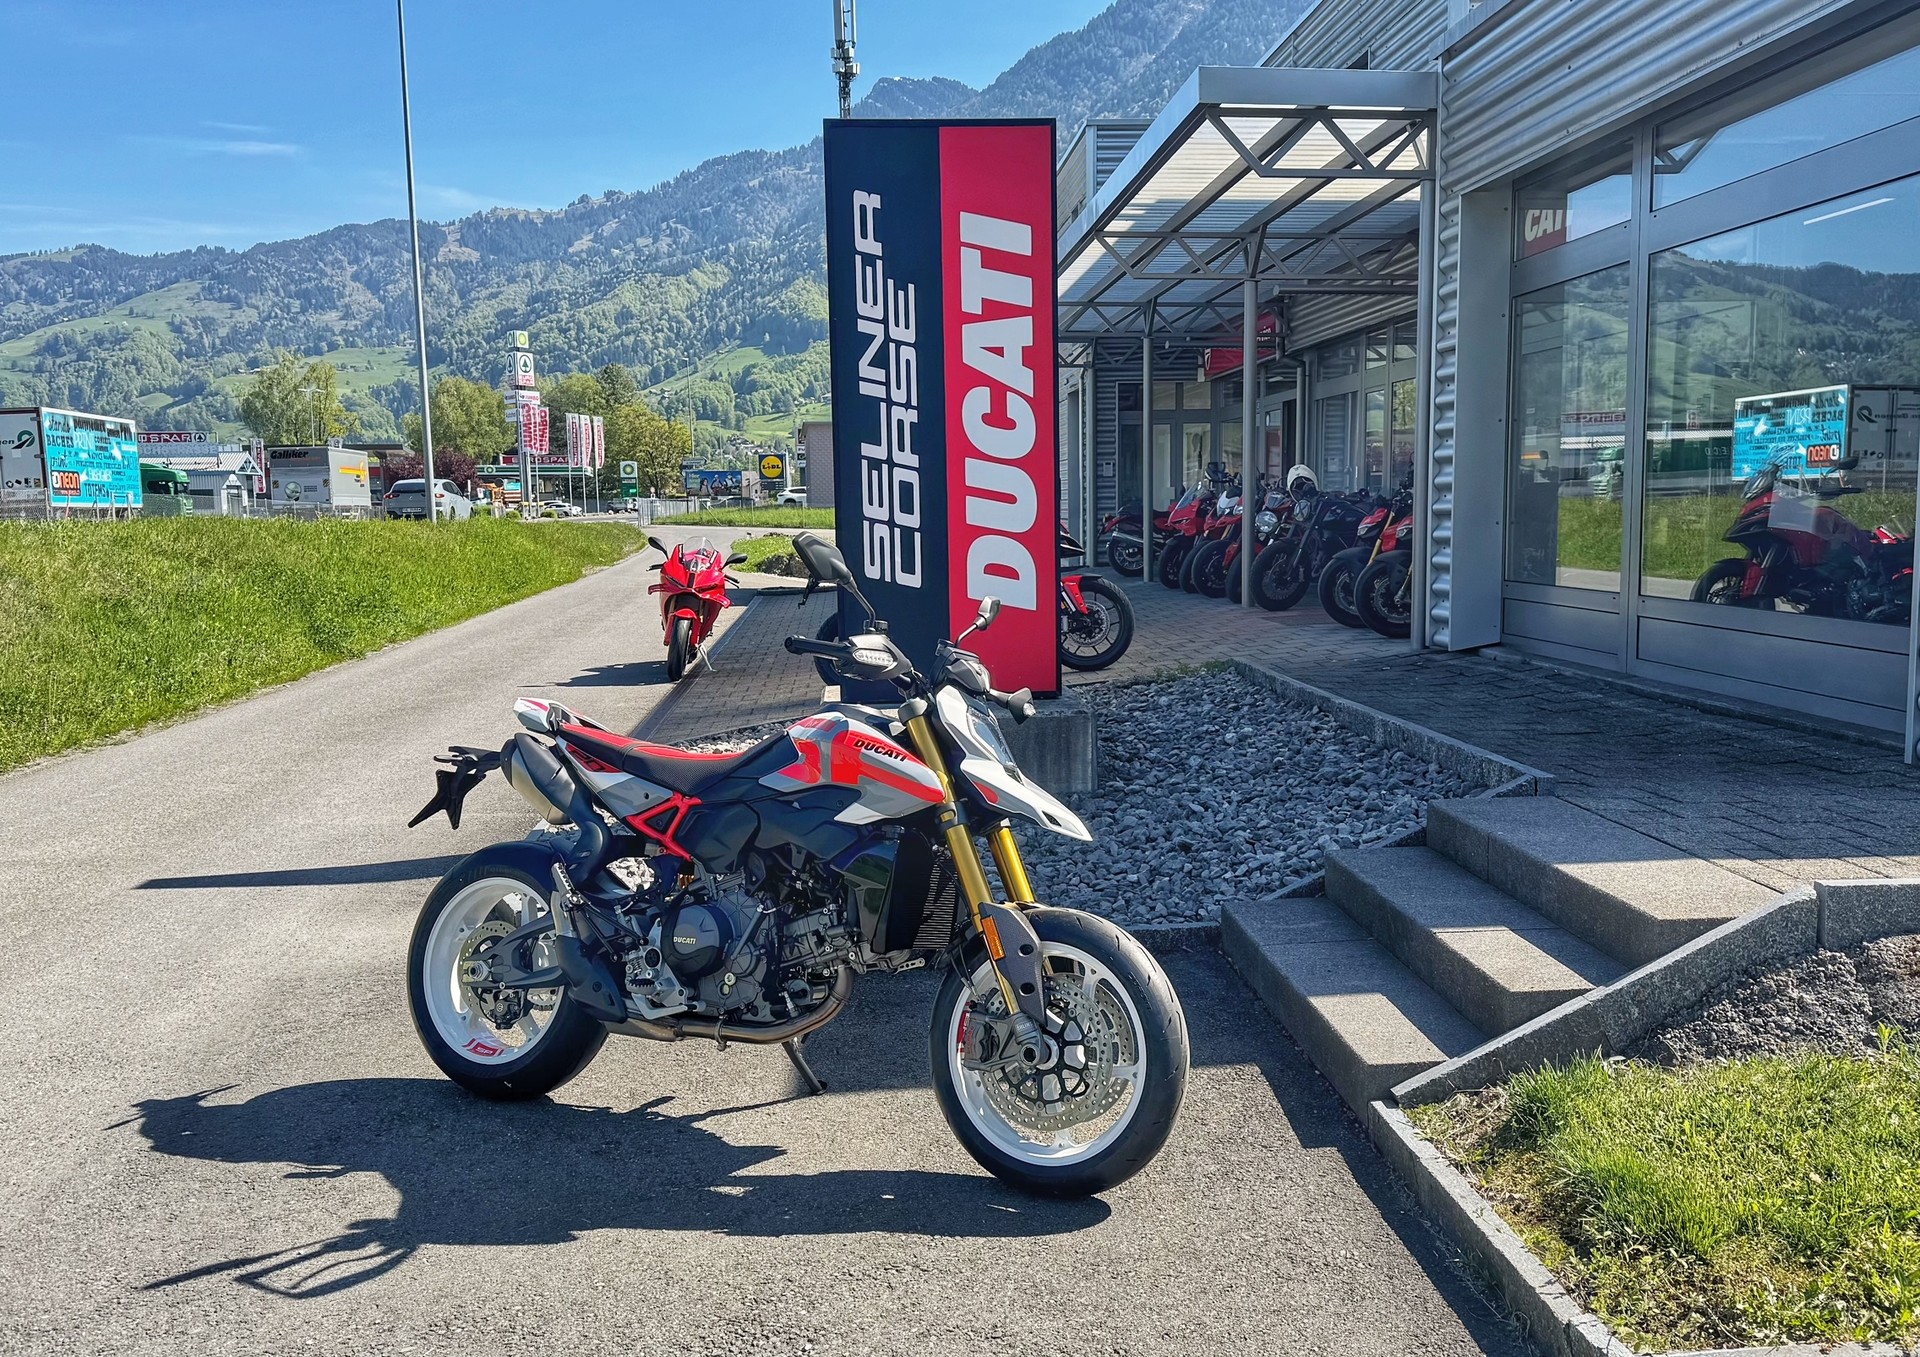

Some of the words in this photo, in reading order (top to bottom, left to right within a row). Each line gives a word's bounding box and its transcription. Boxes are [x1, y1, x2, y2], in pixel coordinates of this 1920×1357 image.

[852, 189, 891, 583] SELINER
[521, 403, 532, 449] JUMBO
[959, 211, 1038, 611] DUCATI
[0, 438, 15, 447] en
[46, 434, 74, 449] BACHES
[538, 409, 548, 452] JUMBO
[887, 278, 922, 589] CORSE
[270, 450, 309, 459] Galliker
[854, 739, 908, 763] DUCATI
[673, 936, 697, 945] DUCATI
